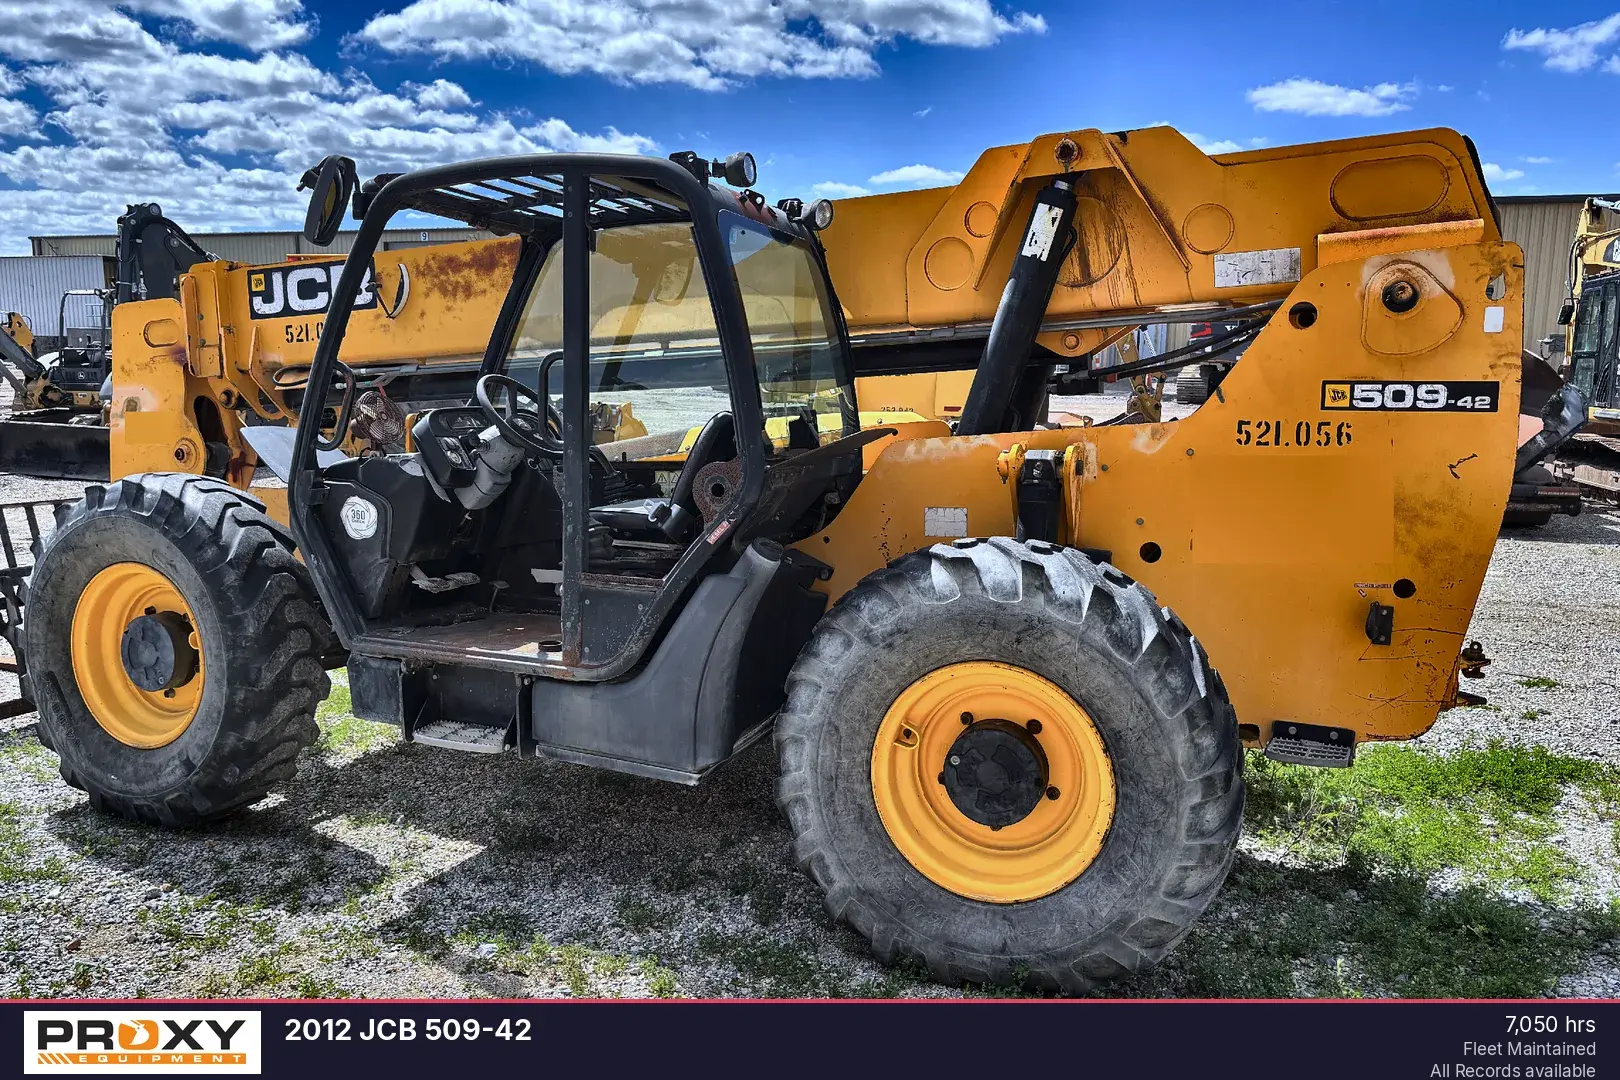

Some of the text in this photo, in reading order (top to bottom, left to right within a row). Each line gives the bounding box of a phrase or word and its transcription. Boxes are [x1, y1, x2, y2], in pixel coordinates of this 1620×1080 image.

[422, 232, 428, 241] 9
[252, 264, 373, 314] JCB
[1352, 383, 1491, 409] 509-42
[1236, 420, 1352, 446] 521.056
[351, 508, 365, 520] 360
